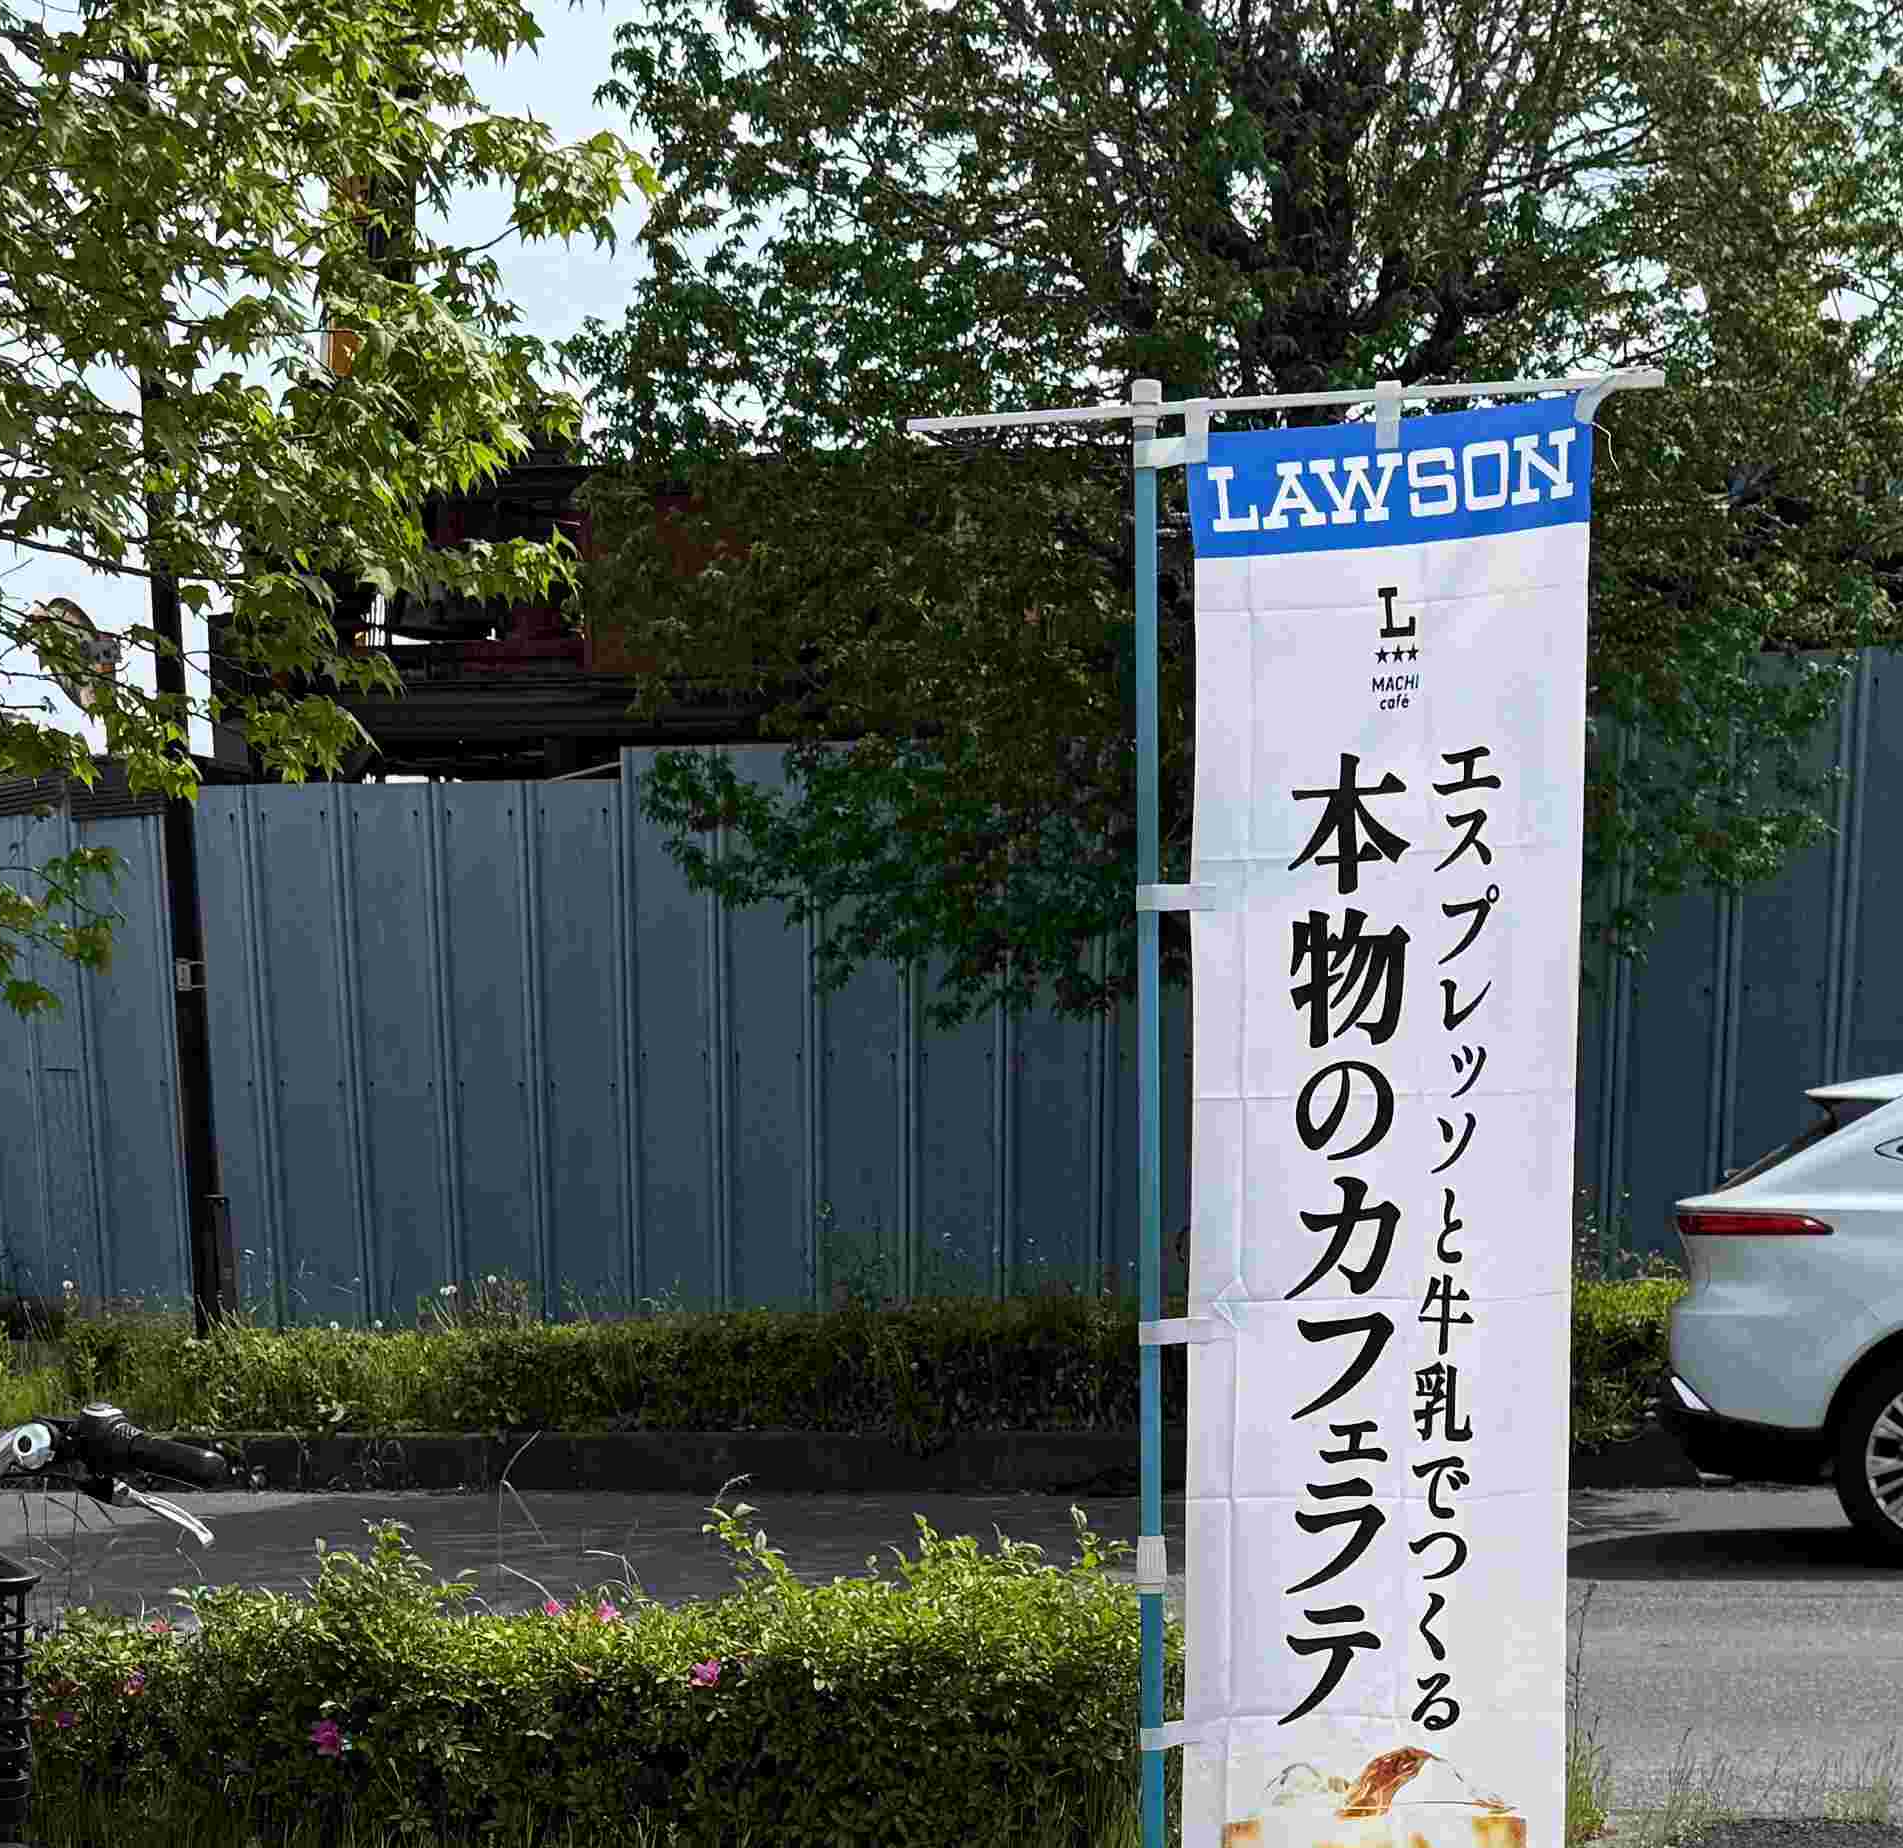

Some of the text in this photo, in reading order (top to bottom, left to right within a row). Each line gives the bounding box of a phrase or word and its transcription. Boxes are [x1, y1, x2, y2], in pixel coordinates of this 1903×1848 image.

[1208, 427, 1577, 533] LAWSON
[1371, 673, 1421, 694] MACHI
[1379, 693, 1409, 711] café
[1277, 753, 1411, 1726] 本物のカフェラテ
[1407, 745, 1503, 1732] エスプレッソと牛乳でつくる
